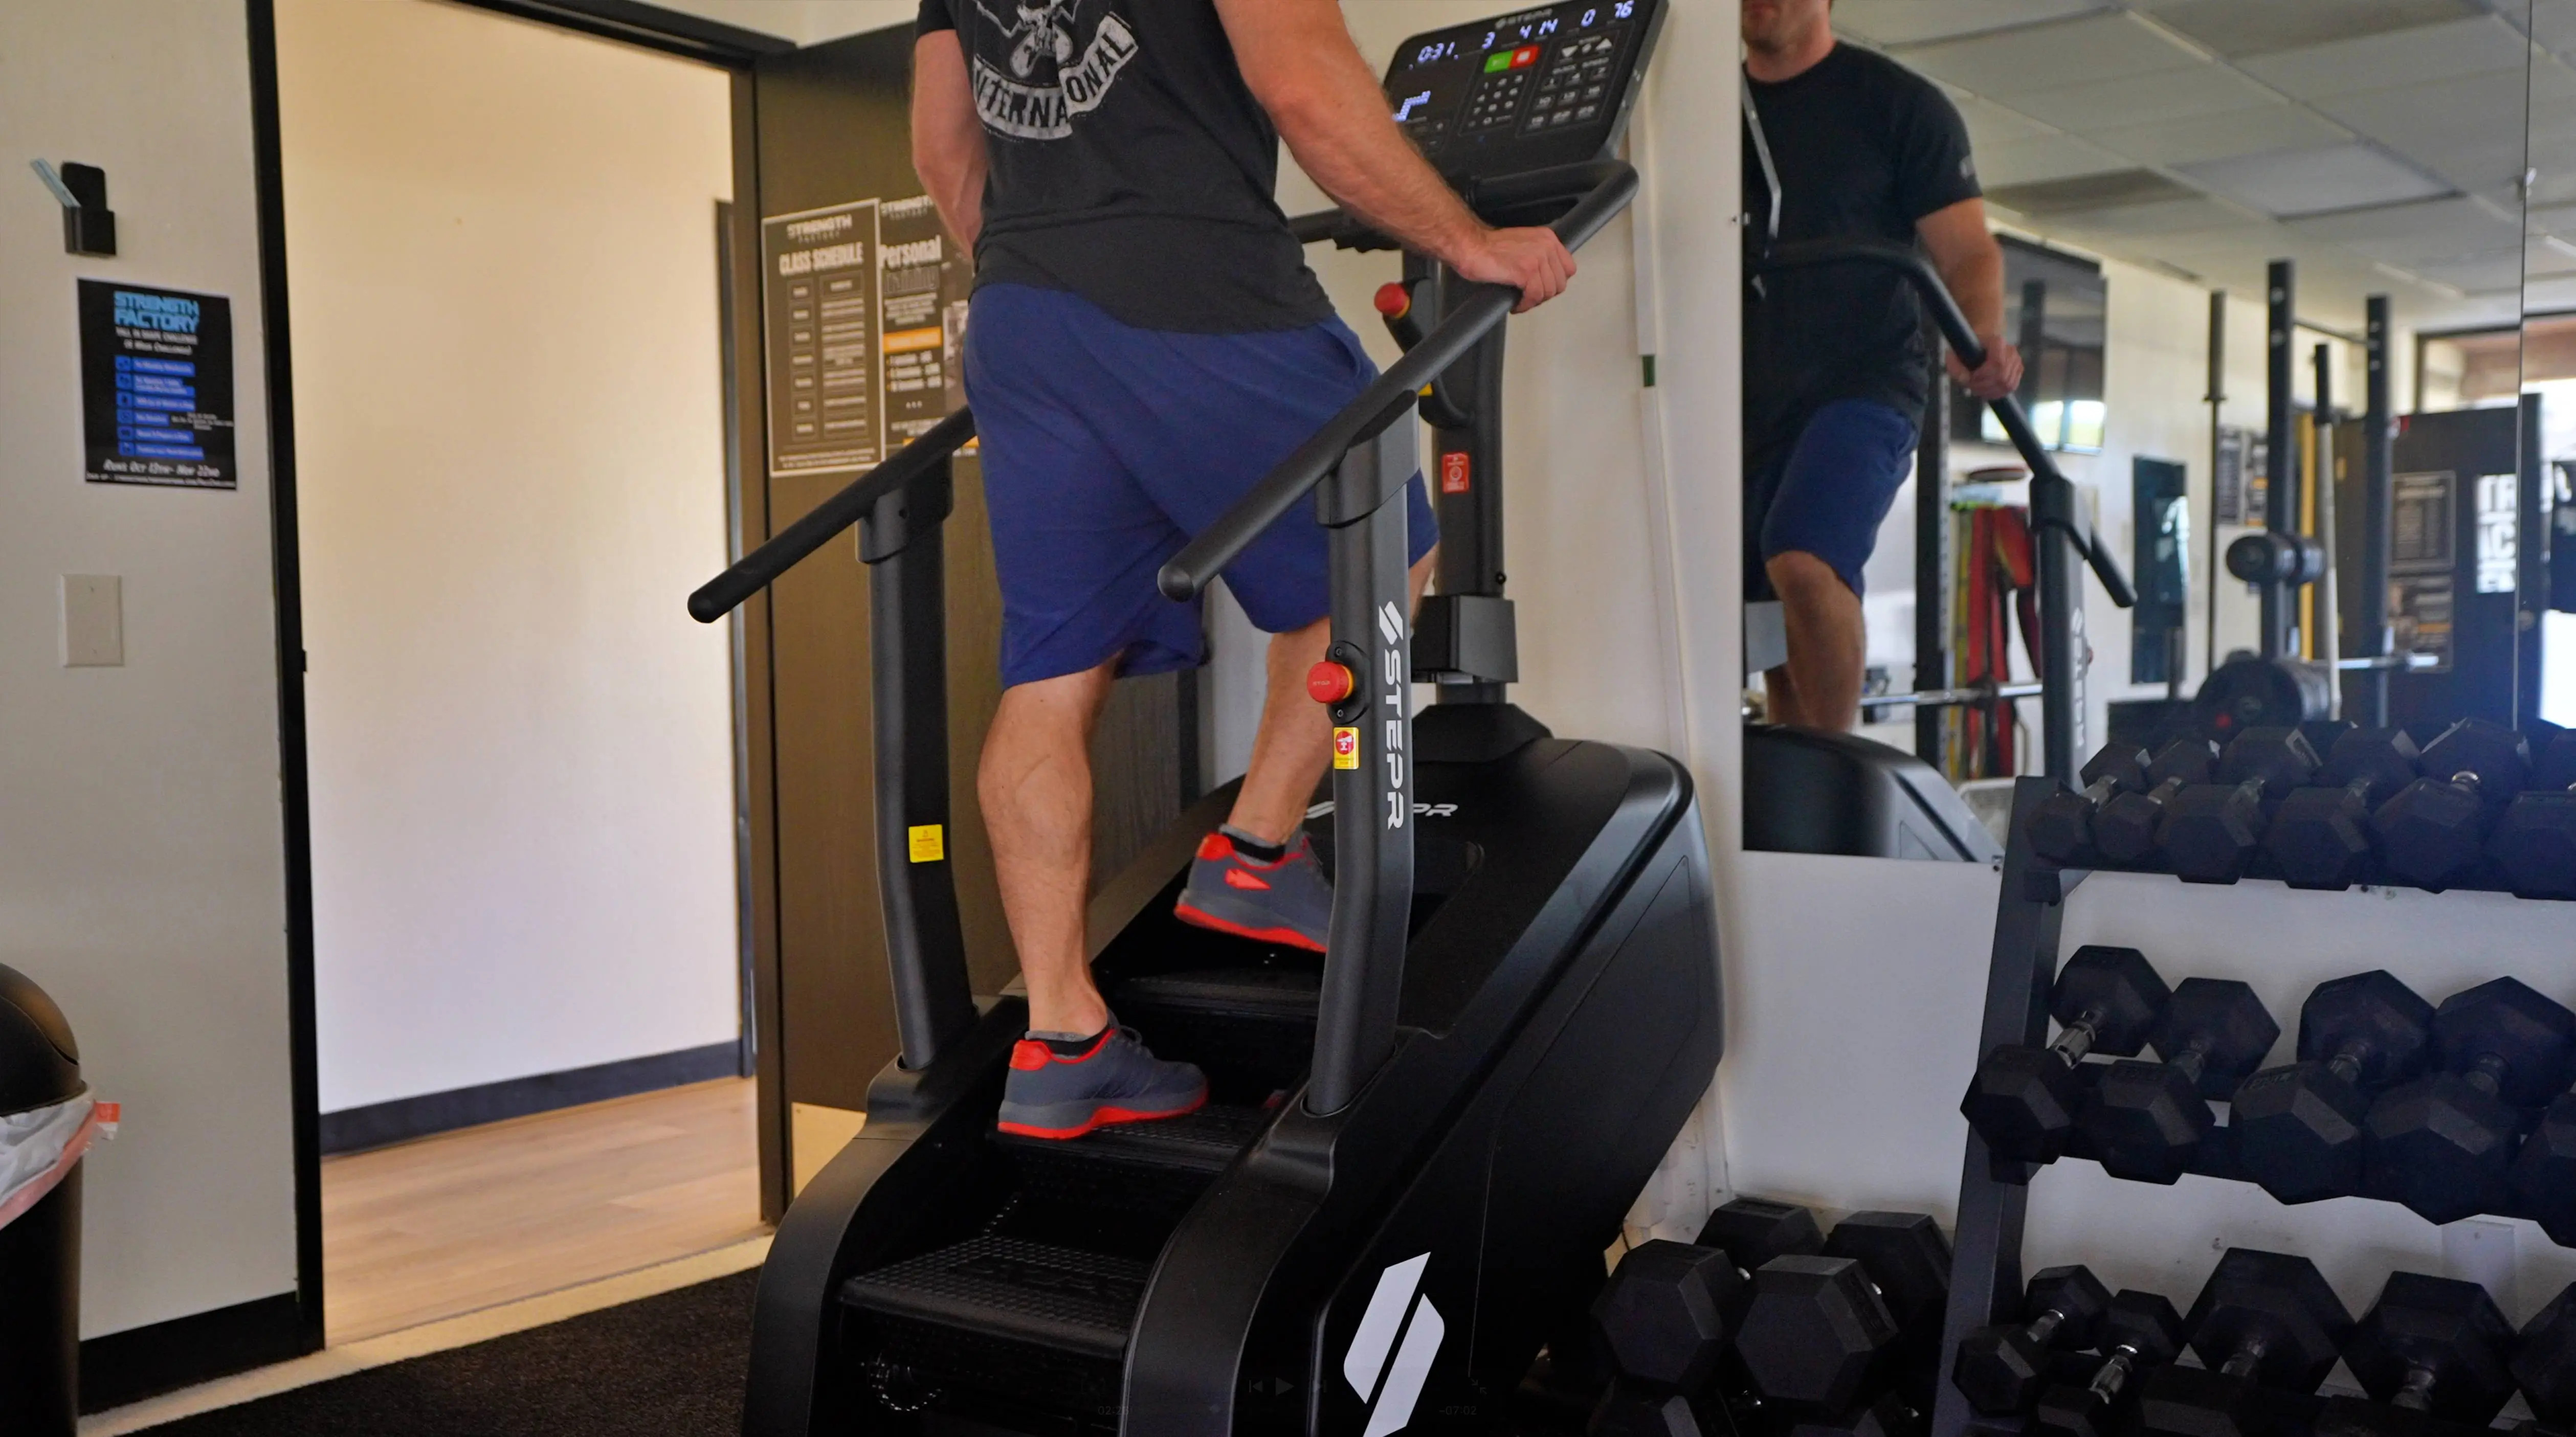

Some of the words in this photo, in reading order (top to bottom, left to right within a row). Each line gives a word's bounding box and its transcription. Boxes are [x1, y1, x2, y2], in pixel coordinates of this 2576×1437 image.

[1481, 32, 1496, 49] 3
[1581, 9, 1596, 27] 0
[1615, 1, 1634, 18] 76
[779, 250, 812, 277] CLASS
[812, 241, 864, 271] SCHEDULE
[878, 234, 942, 268] Personal
[113, 290, 200, 317] STRENGTH
[113, 307, 200, 334] FACTORY
[1384, 649, 1404, 830] STEPR
